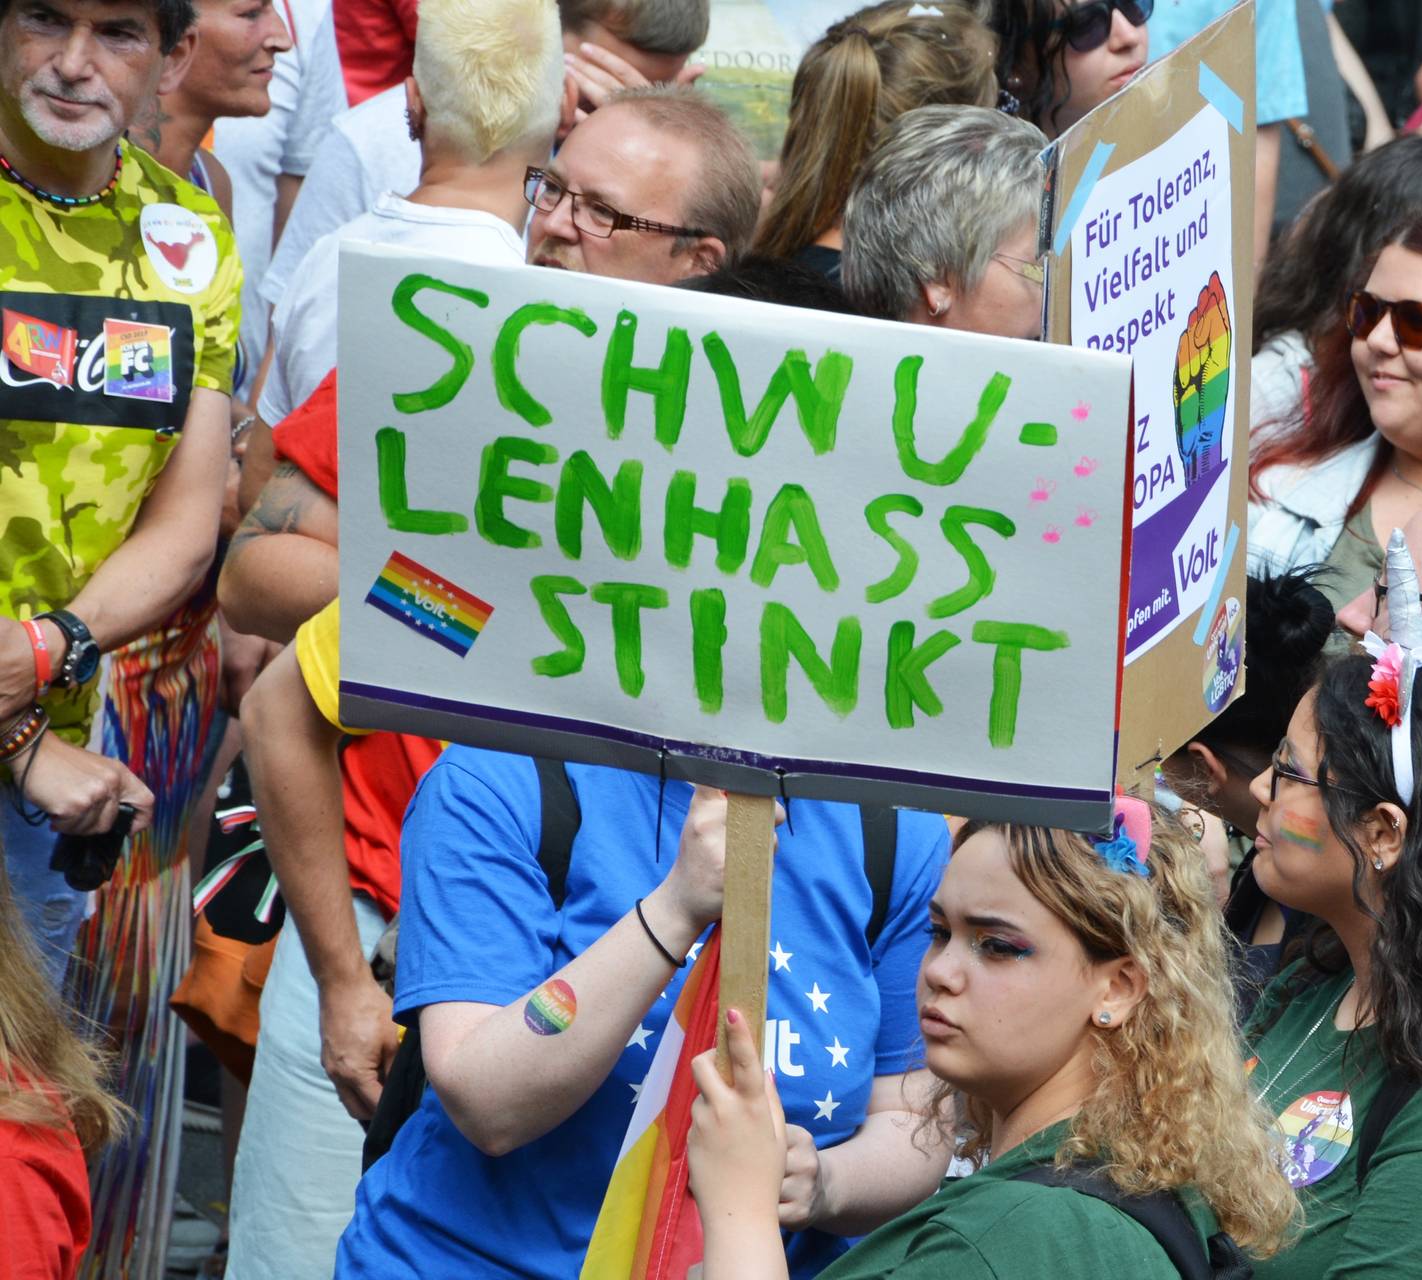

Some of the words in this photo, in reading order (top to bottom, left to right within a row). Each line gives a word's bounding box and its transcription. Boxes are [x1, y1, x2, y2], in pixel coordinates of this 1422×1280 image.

[1085, 208, 1122, 258] Für
[1128, 149, 1216, 230] Toleranz,
[1084, 235, 1170, 313] Vielfalt
[1176, 199, 1208, 258] und
[120, 346, 151, 376] FC
[392, 273, 1058, 487] SCHWU-
[1133, 454, 1175, 510] OPA
[376, 427, 1016, 620] LENHASS
[1178, 527, 1218, 592] Volt
[414, 589, 448, 619] Volt
[1127, 607, 1151, 638] pfen
[1152, 587, 1172, 615] mit.
[529, 575, 1070, 749] STINKT
[764, 1019, 805, 1077] lt
